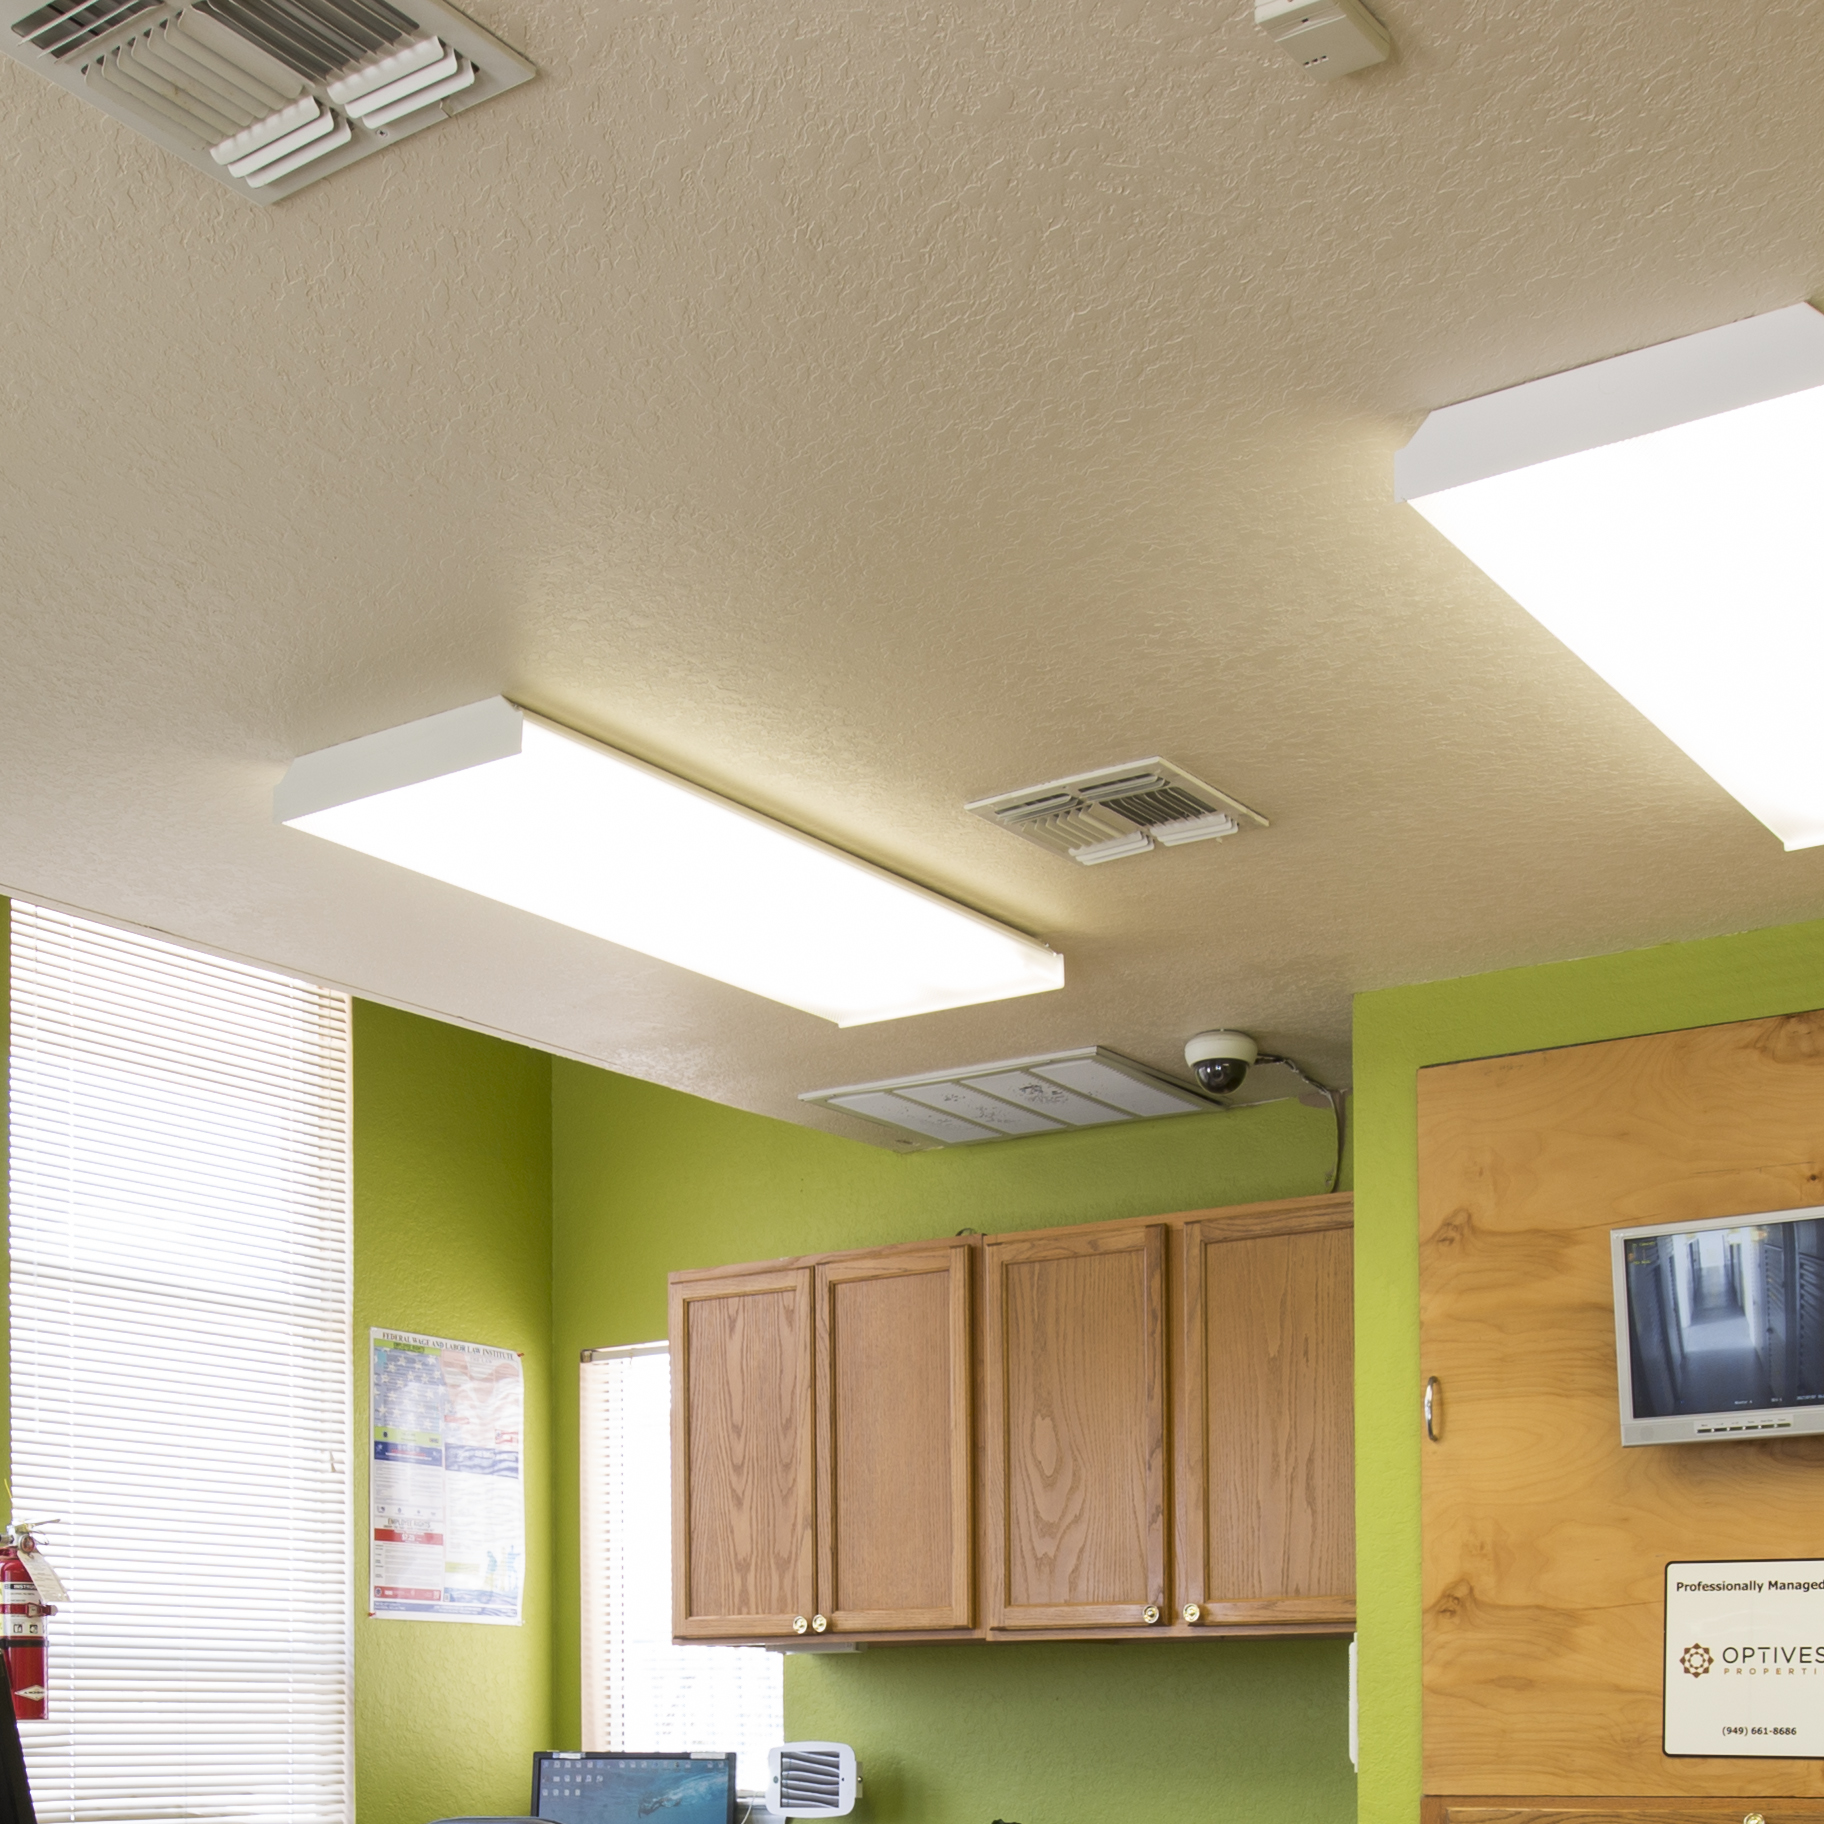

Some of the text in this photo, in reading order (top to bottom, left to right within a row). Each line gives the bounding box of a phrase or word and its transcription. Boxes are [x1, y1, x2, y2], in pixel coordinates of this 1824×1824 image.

[382, 1332, 410, 1342] FEDERAL
[412, 1336, 429, 1346] WAGE
[432, 1340, 444, 1348] AND
[445, 1343, 466, 1352] LABOR
[467, 1346, 481, 1354] LAW
[483, 1348, 514, 1360] INSTITUTE
[1676, 1580, 1764, 1592] Professionally
[1722, 1726, 1796, 1736] (949) 661-8686
